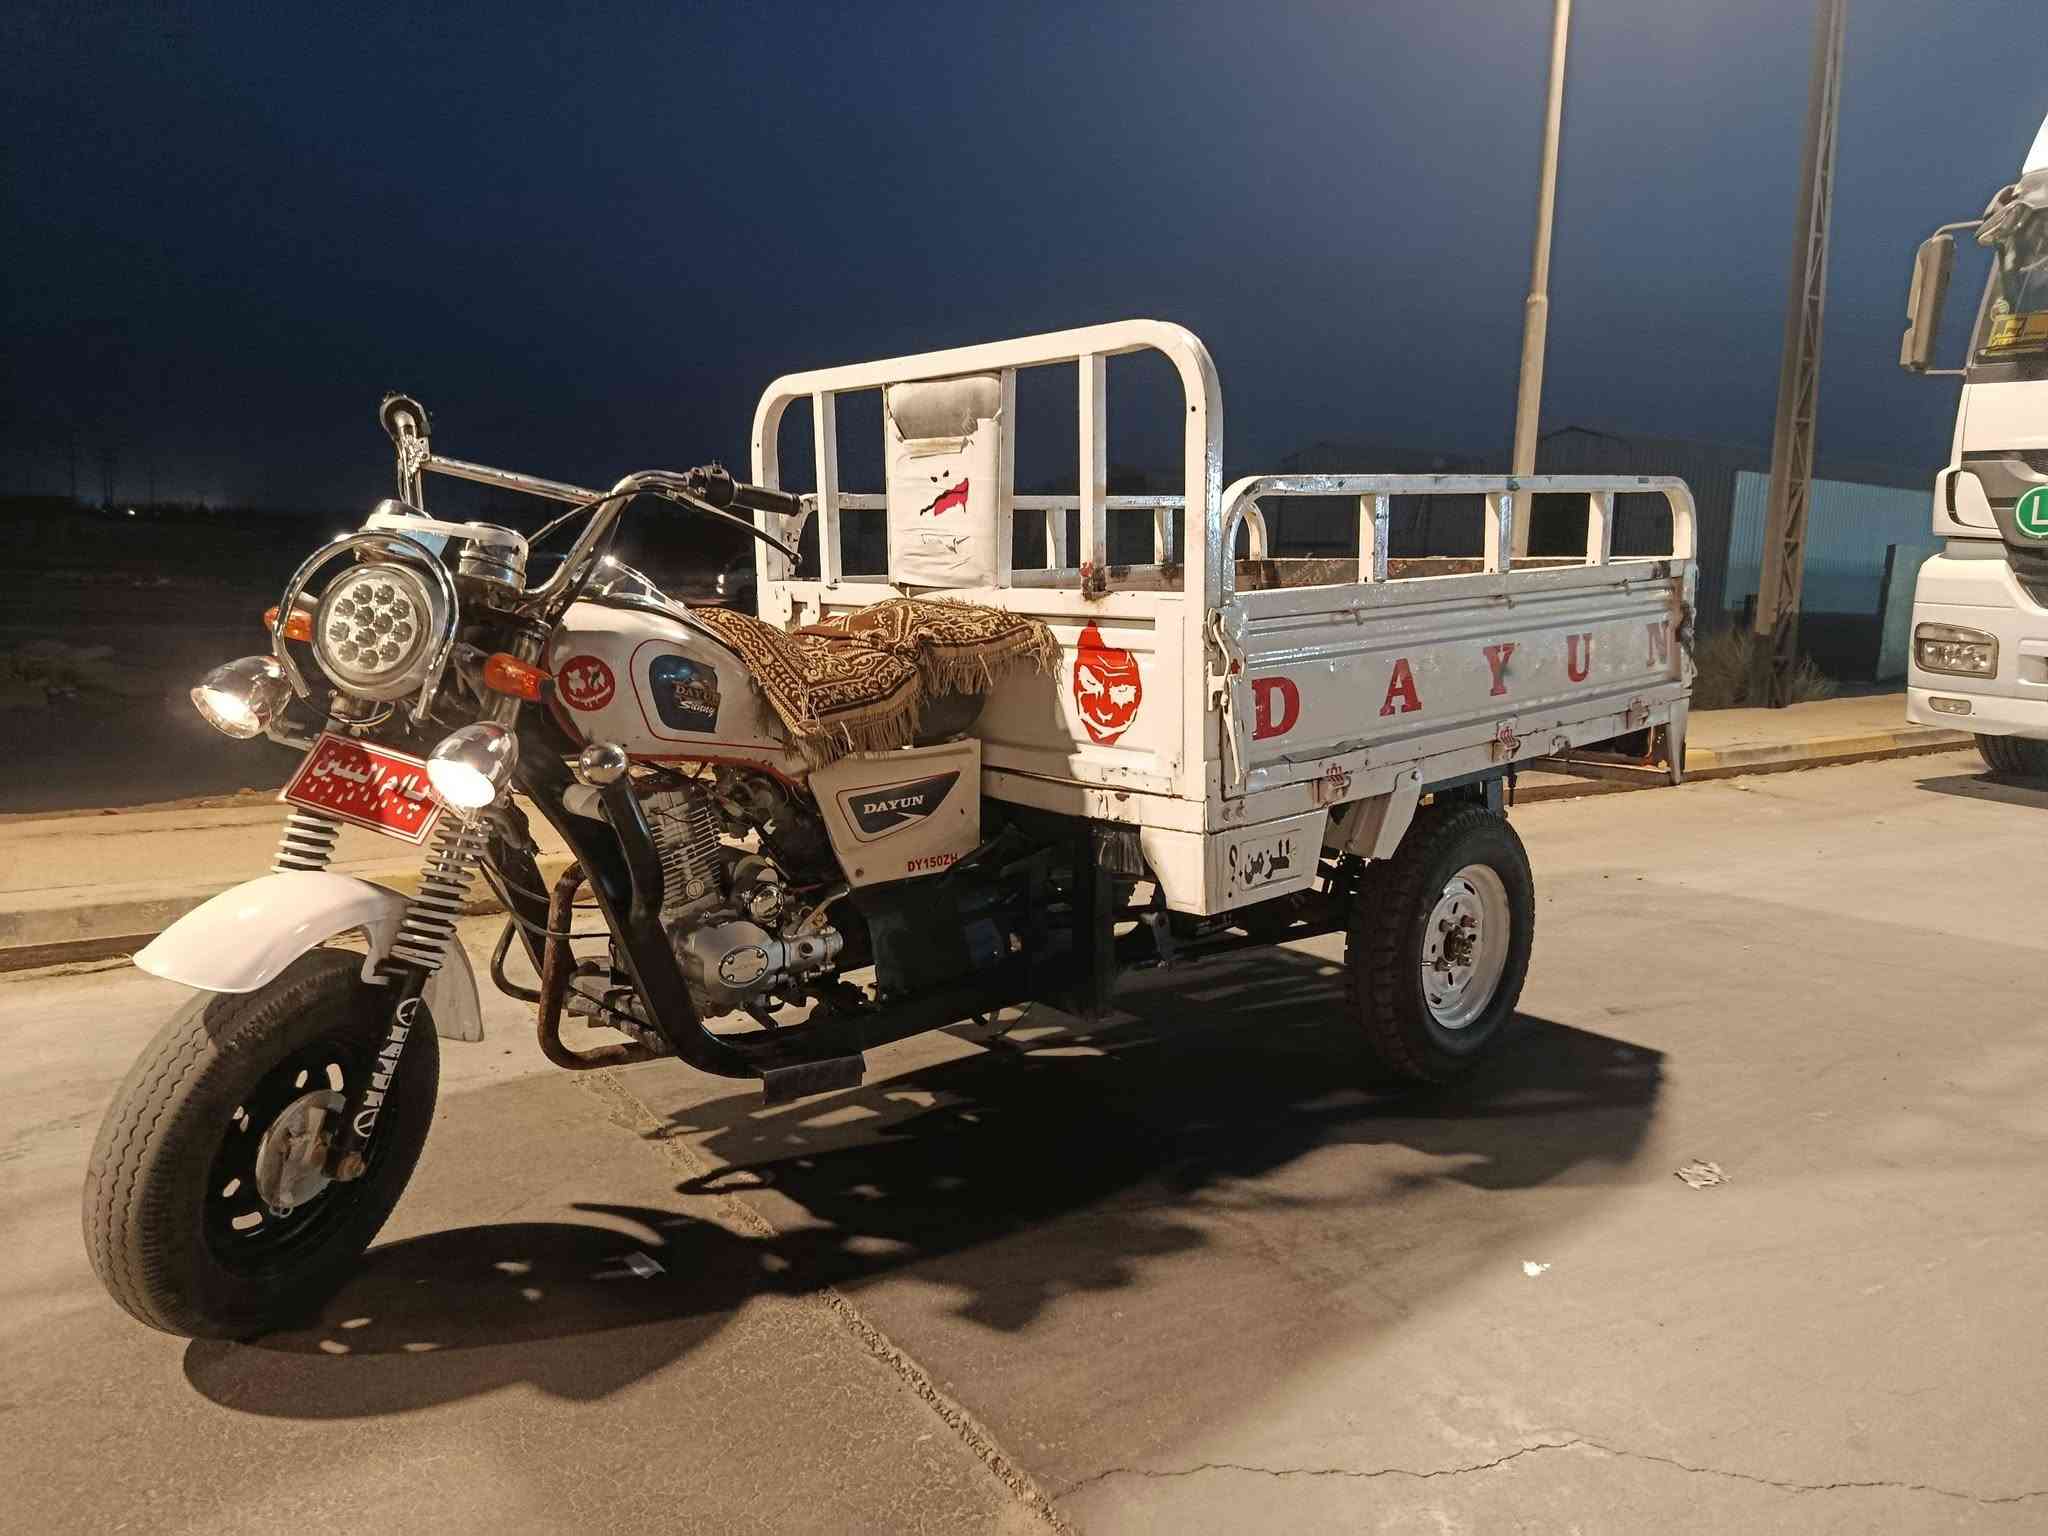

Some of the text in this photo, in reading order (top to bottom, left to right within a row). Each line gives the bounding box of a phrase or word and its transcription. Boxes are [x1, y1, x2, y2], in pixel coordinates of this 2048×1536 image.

[2031, 495, 2048, 526] L
[679, 700, 715, 718] Sunny
[863, 794, 925, 815] DAYUN
[907, 853, 958, 873] DY150ZH
